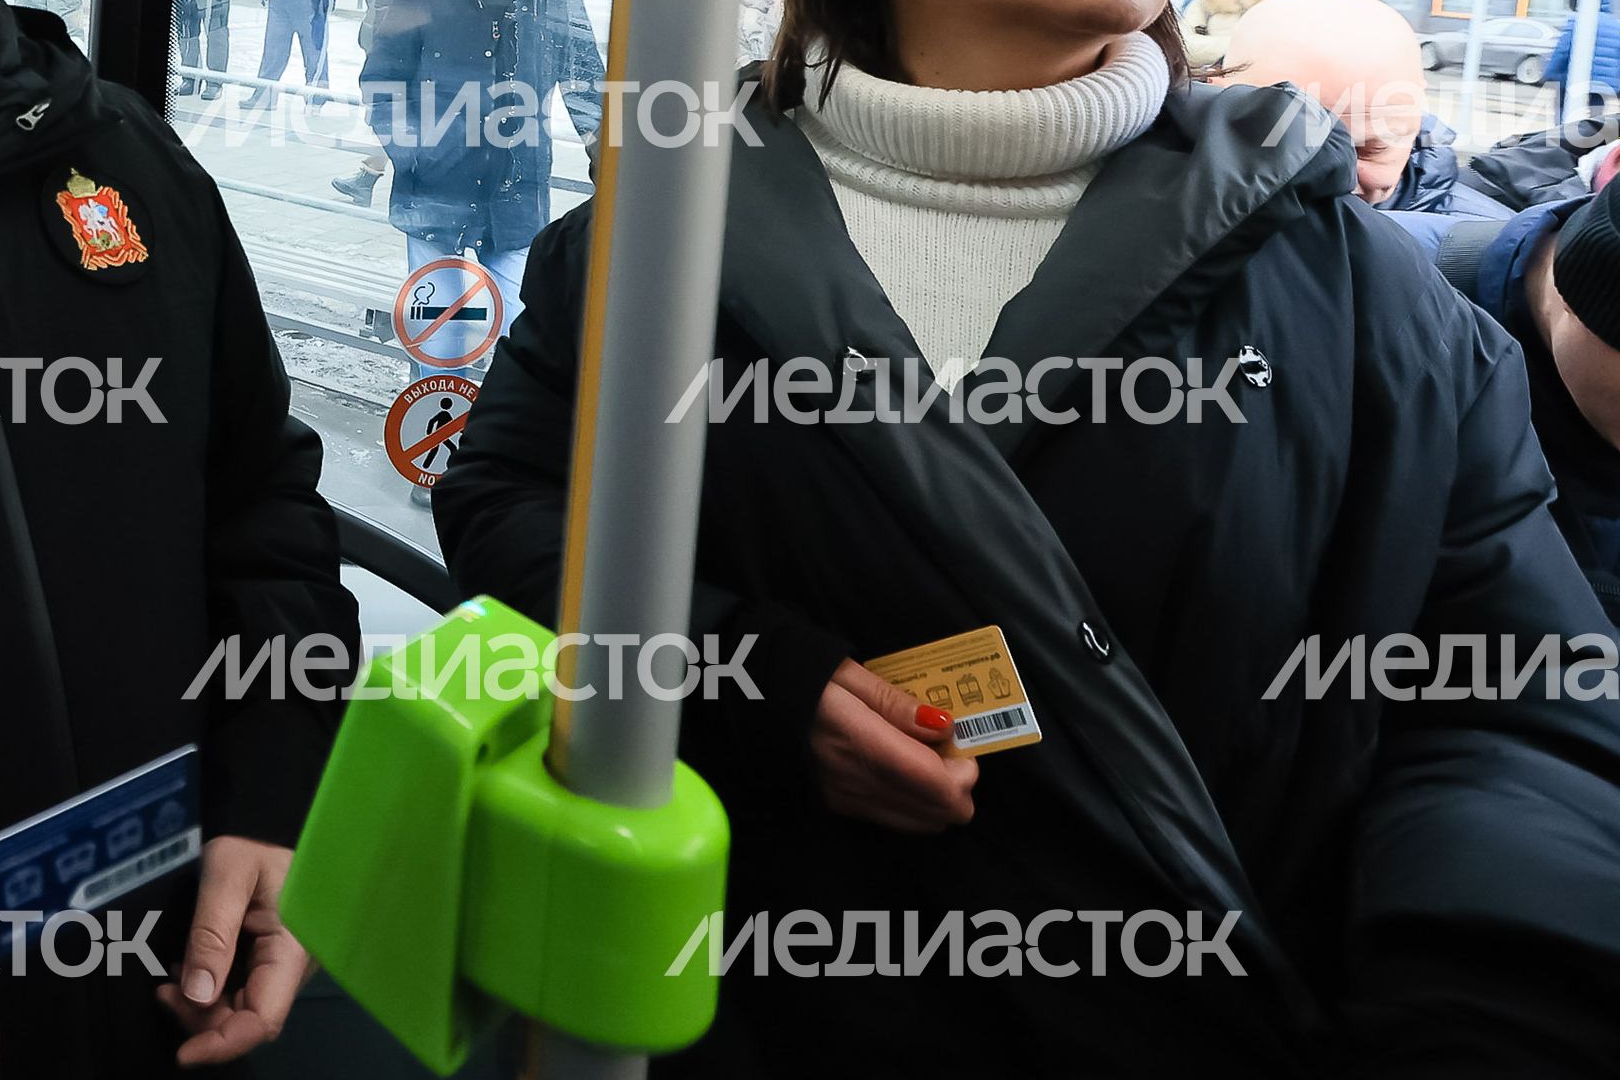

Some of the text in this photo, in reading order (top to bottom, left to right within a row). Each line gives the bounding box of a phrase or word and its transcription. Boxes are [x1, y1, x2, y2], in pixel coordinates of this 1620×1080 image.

[403, 379, 477, 404] ВЫХОДА НЕ
[418, 473, 436, 486] NO
